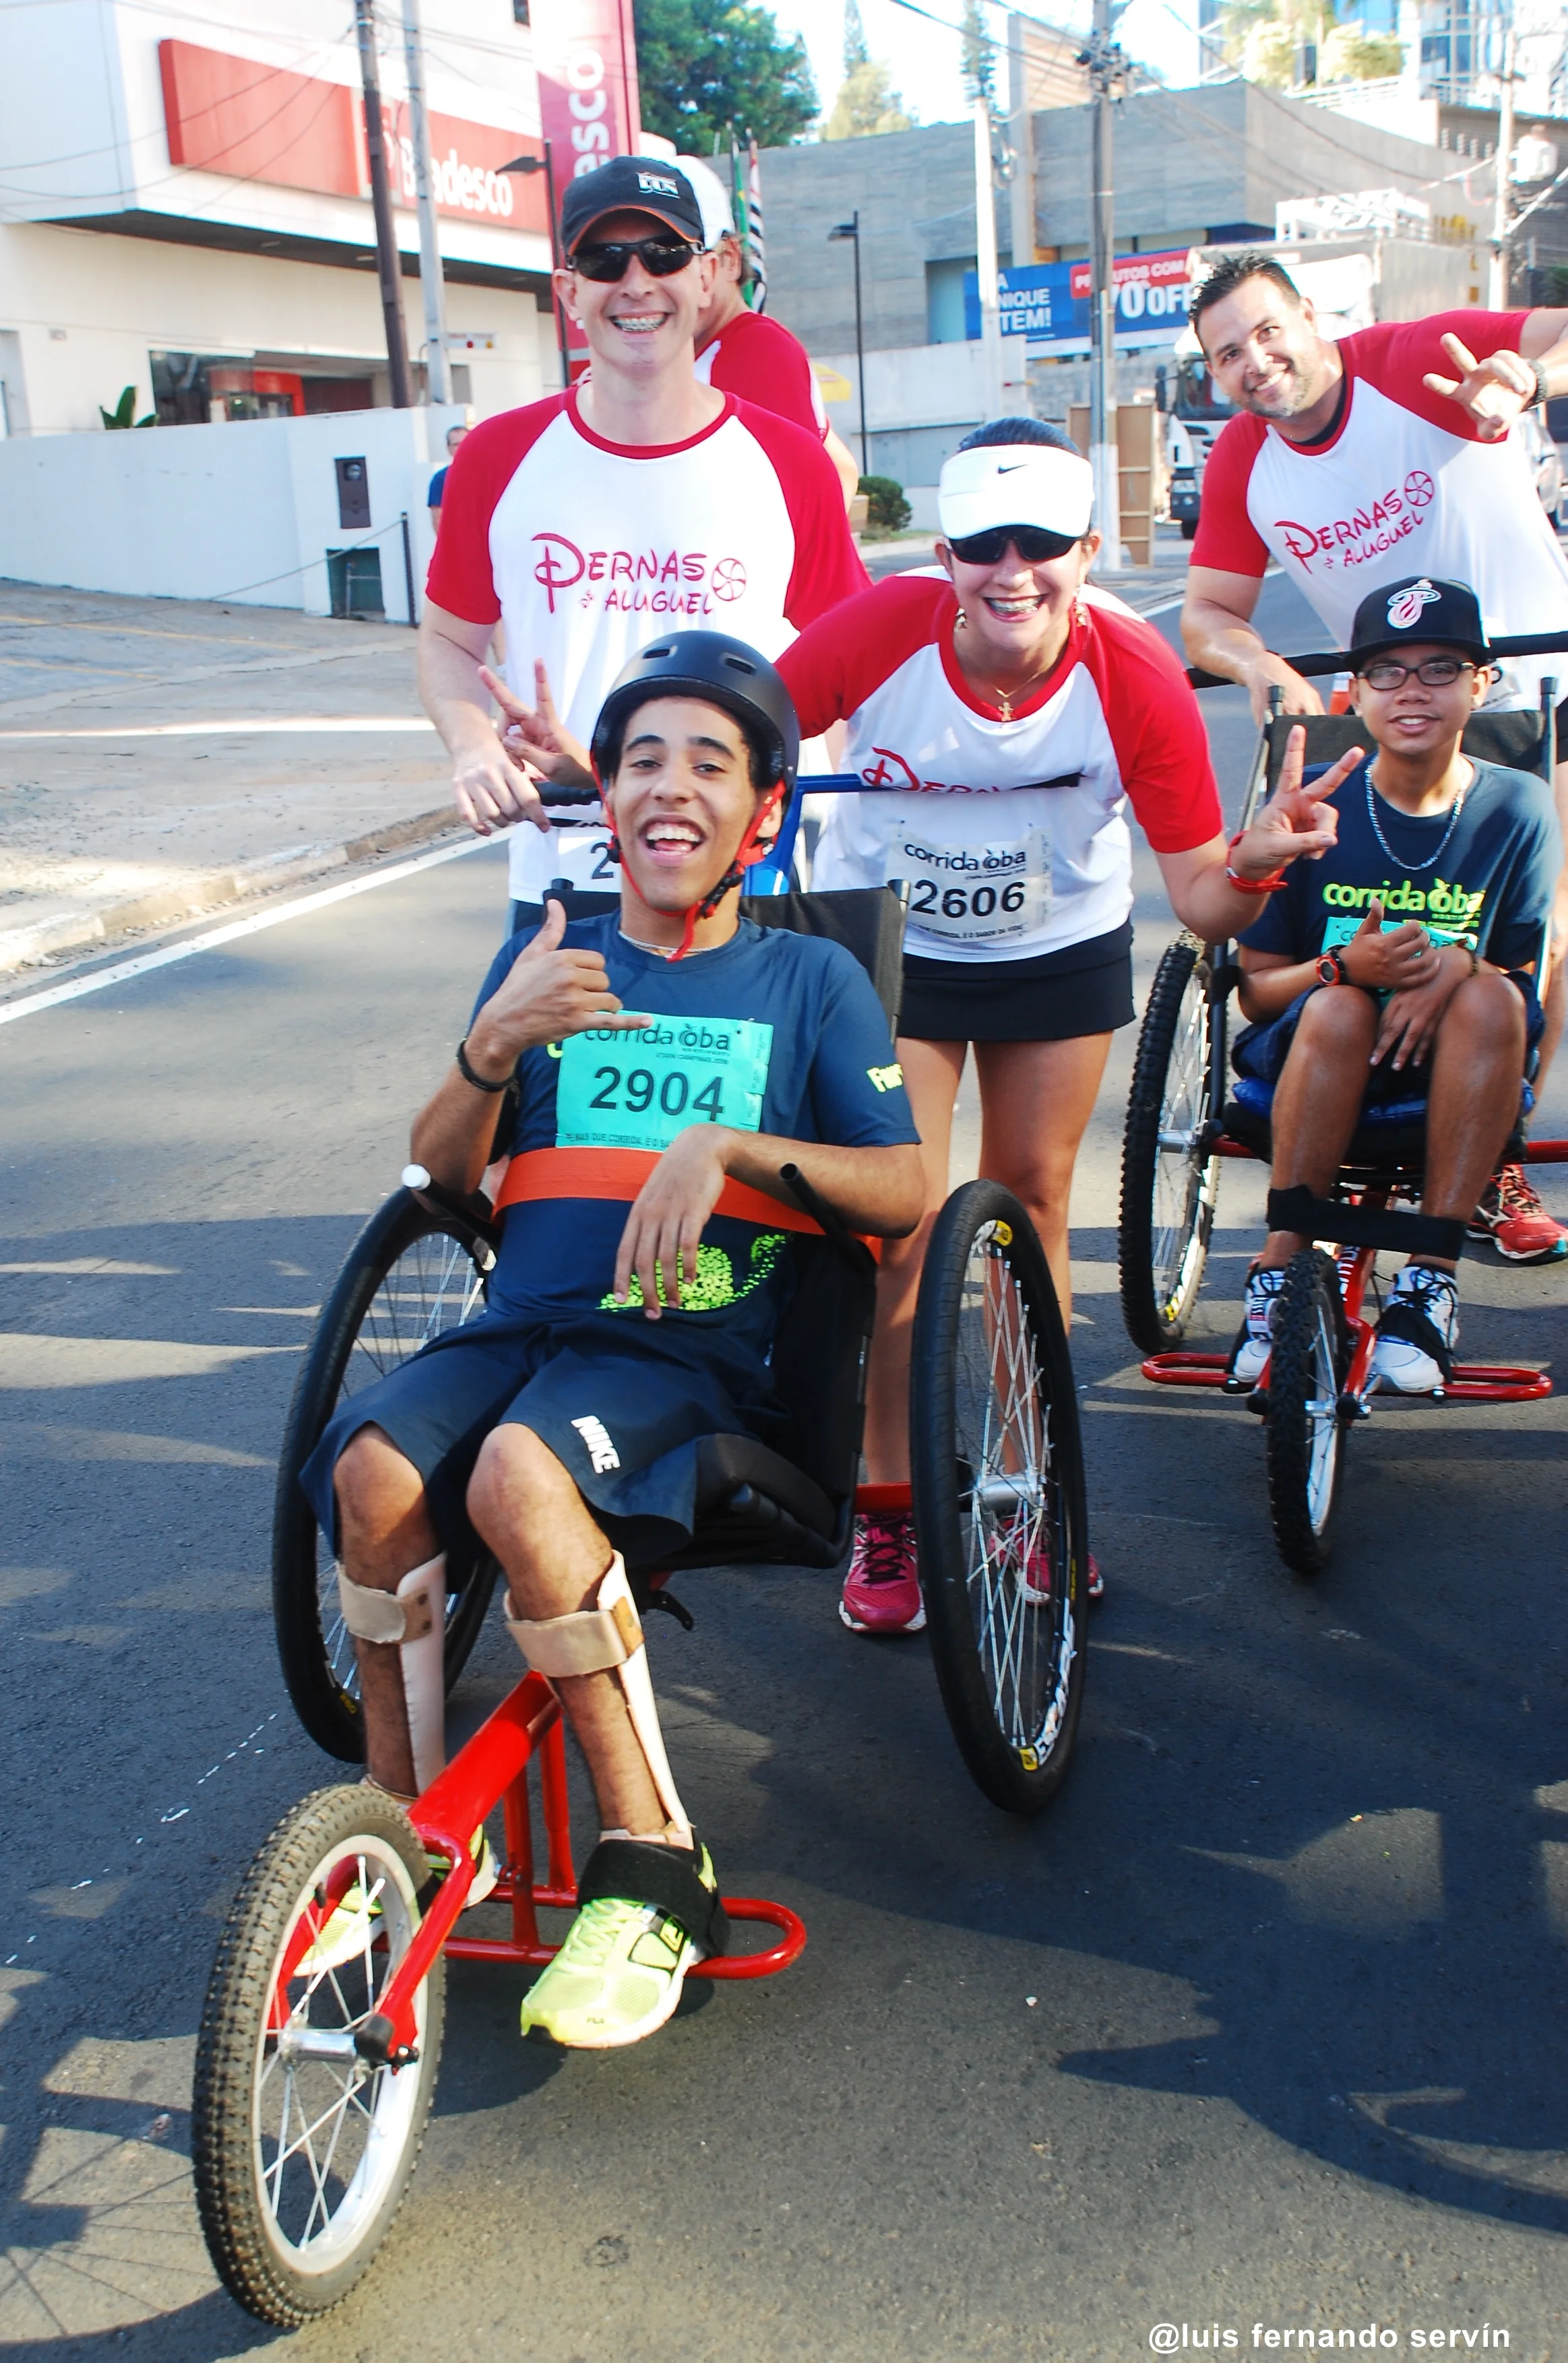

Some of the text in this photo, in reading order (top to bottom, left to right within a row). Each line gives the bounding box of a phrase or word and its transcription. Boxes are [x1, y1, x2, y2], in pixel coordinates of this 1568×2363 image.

[400, 137, 514, 217] Badesco
[1151, 260, 1185, 278] COM
[998, 288, 1051, 310] NIQUE
[1274, 489, 1404, 575] PERNAS
[1343, 510, 1423, 567] ALUGUEL
[531, 532, 708, 614] PERNAS
[604, 588, 713, 615] ALUGUEL
[904, 843, 978, 871] corrida
[911, 879, 1026, 919] 2606
[1322, 880, 1426, 911] corrida
[589, 1067, 724, 1122] 2904
